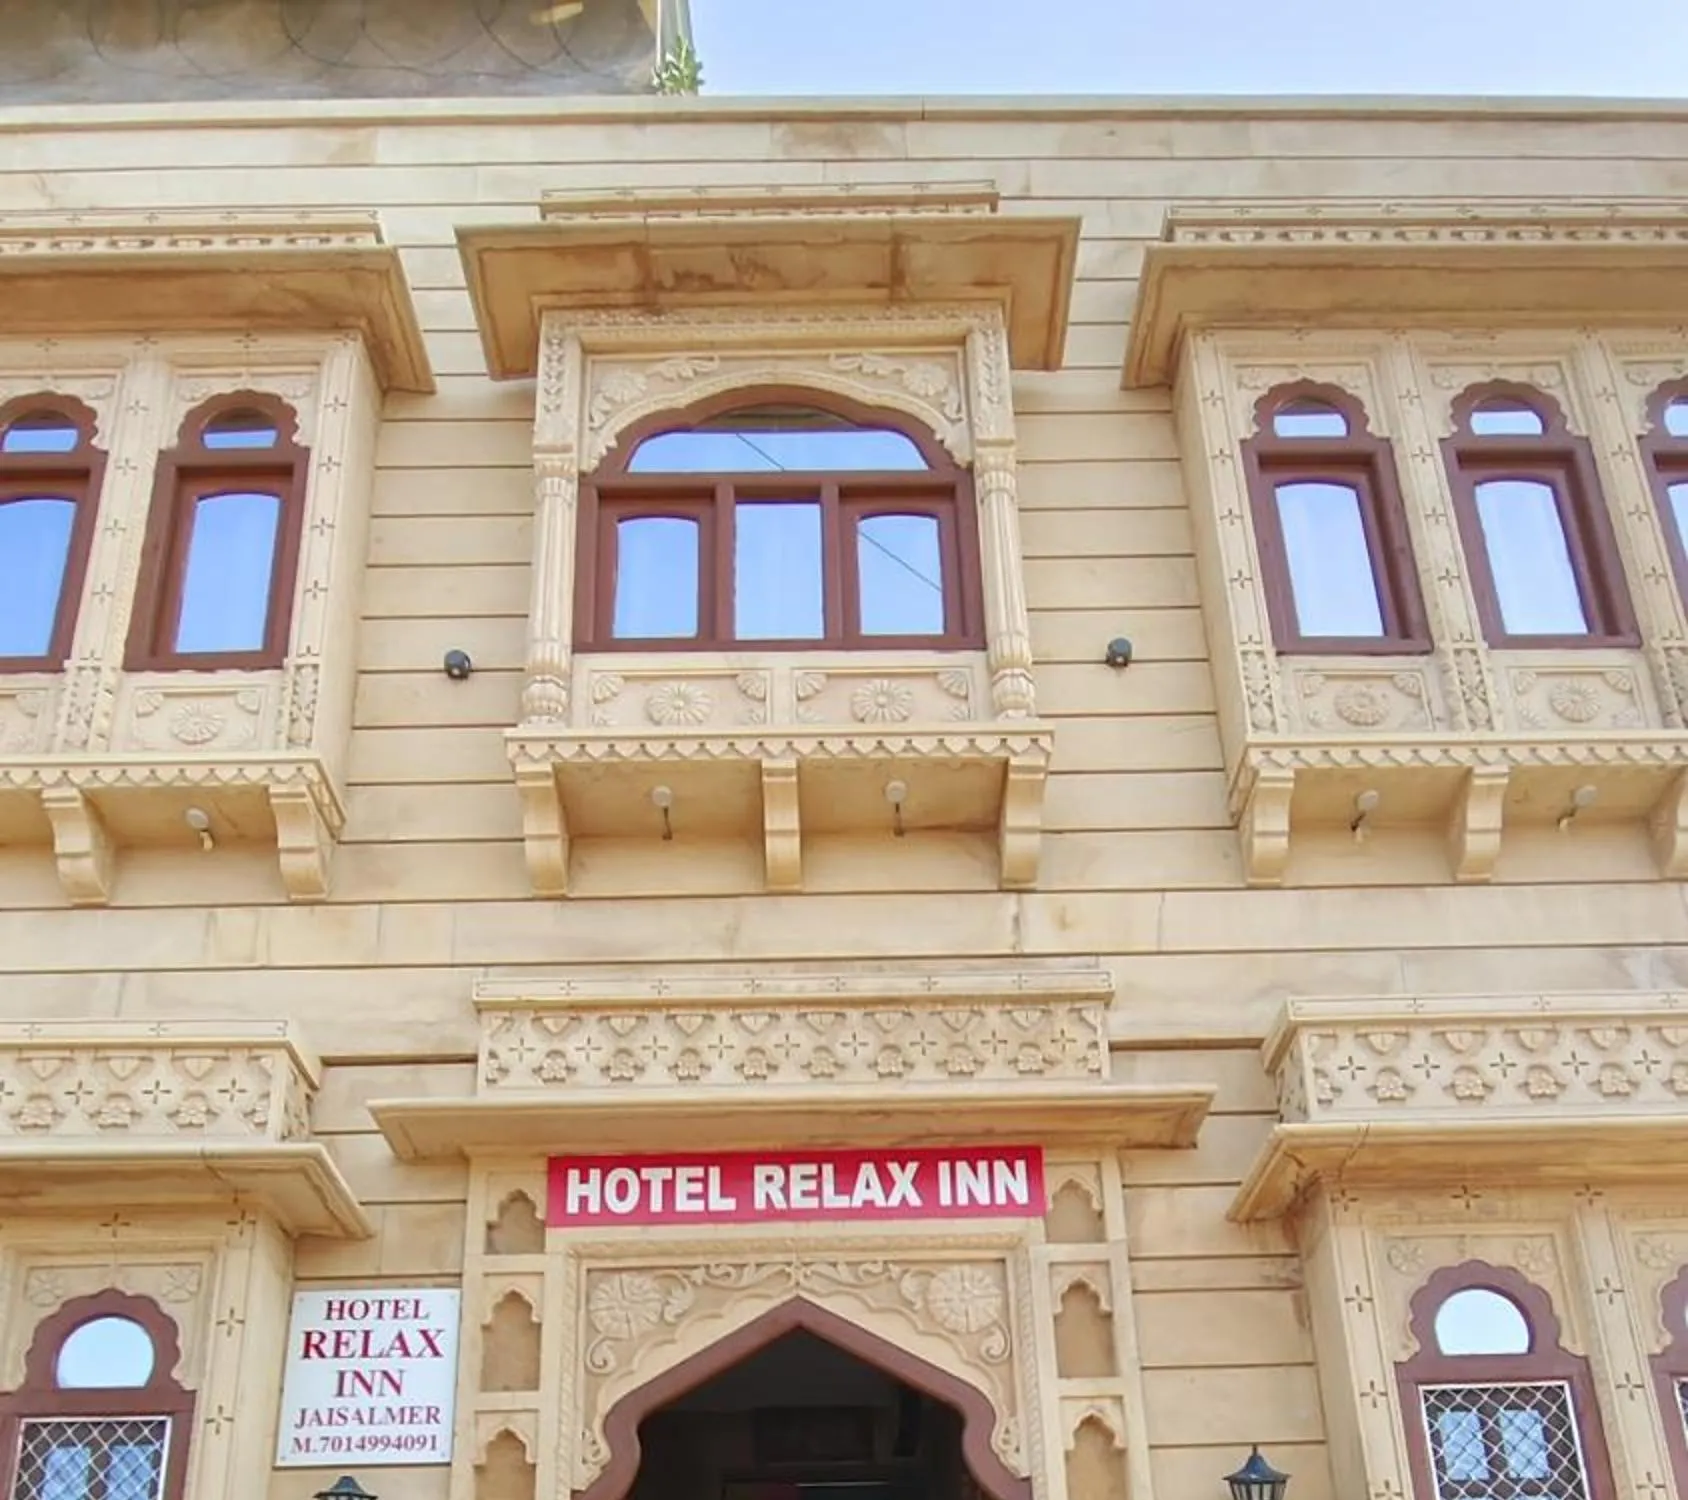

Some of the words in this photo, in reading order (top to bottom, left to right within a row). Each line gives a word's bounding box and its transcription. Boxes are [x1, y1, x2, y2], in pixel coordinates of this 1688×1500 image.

[566, 1166, 736, 1215] HOTEL
[752, 1161, 923, 1211] RELAX
[937, 1159, 1029, 1208] INN
[324, 1299, 430, 1321] HOTEL
[301, 1328, 445, 1360] RELAX
[334, 1369, 406, 1398] INN
[294, 1405, 441, 1429] JAISALMER
[291, 1434, 438, 1453] M.7014994091
